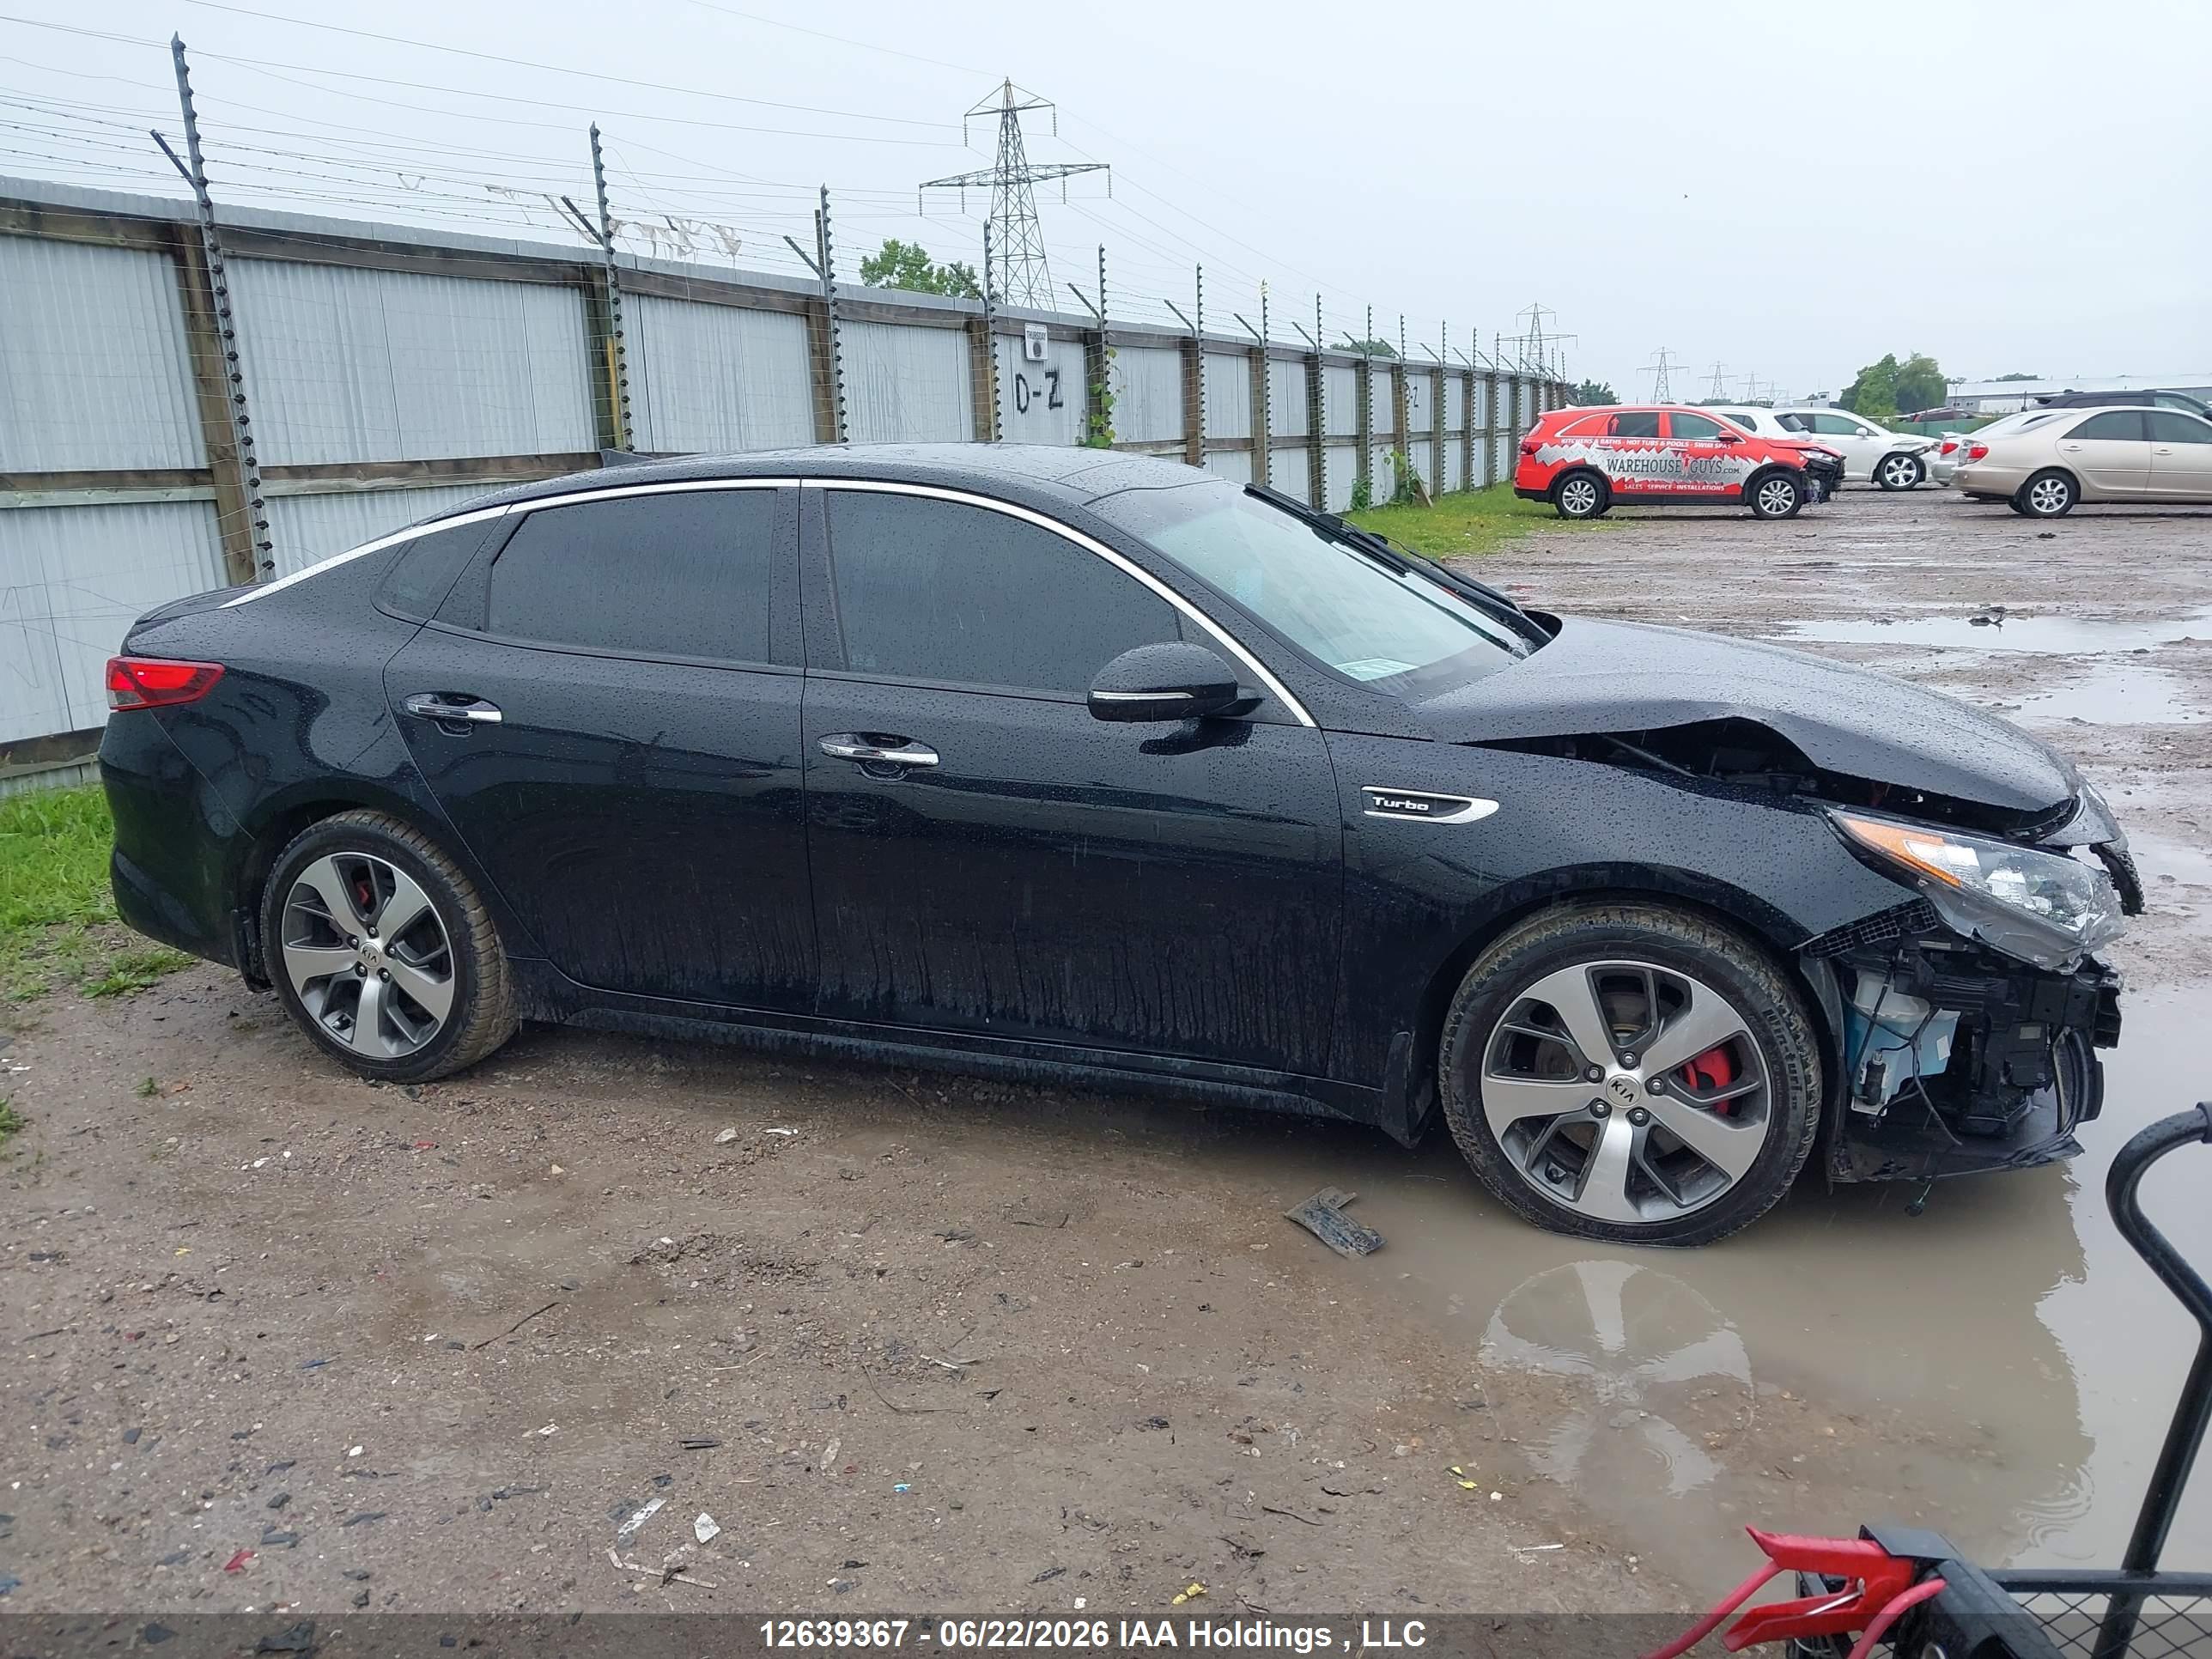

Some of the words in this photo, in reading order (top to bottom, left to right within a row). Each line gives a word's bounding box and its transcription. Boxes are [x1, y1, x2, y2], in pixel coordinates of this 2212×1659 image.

[1607, 459, 1682, 473] WAREHOUSE
[1371, 796, 1430, 811] Turbo
[362, 946, 377, 963] KIA
[1611, 1080, 1635, 1103] KIA
